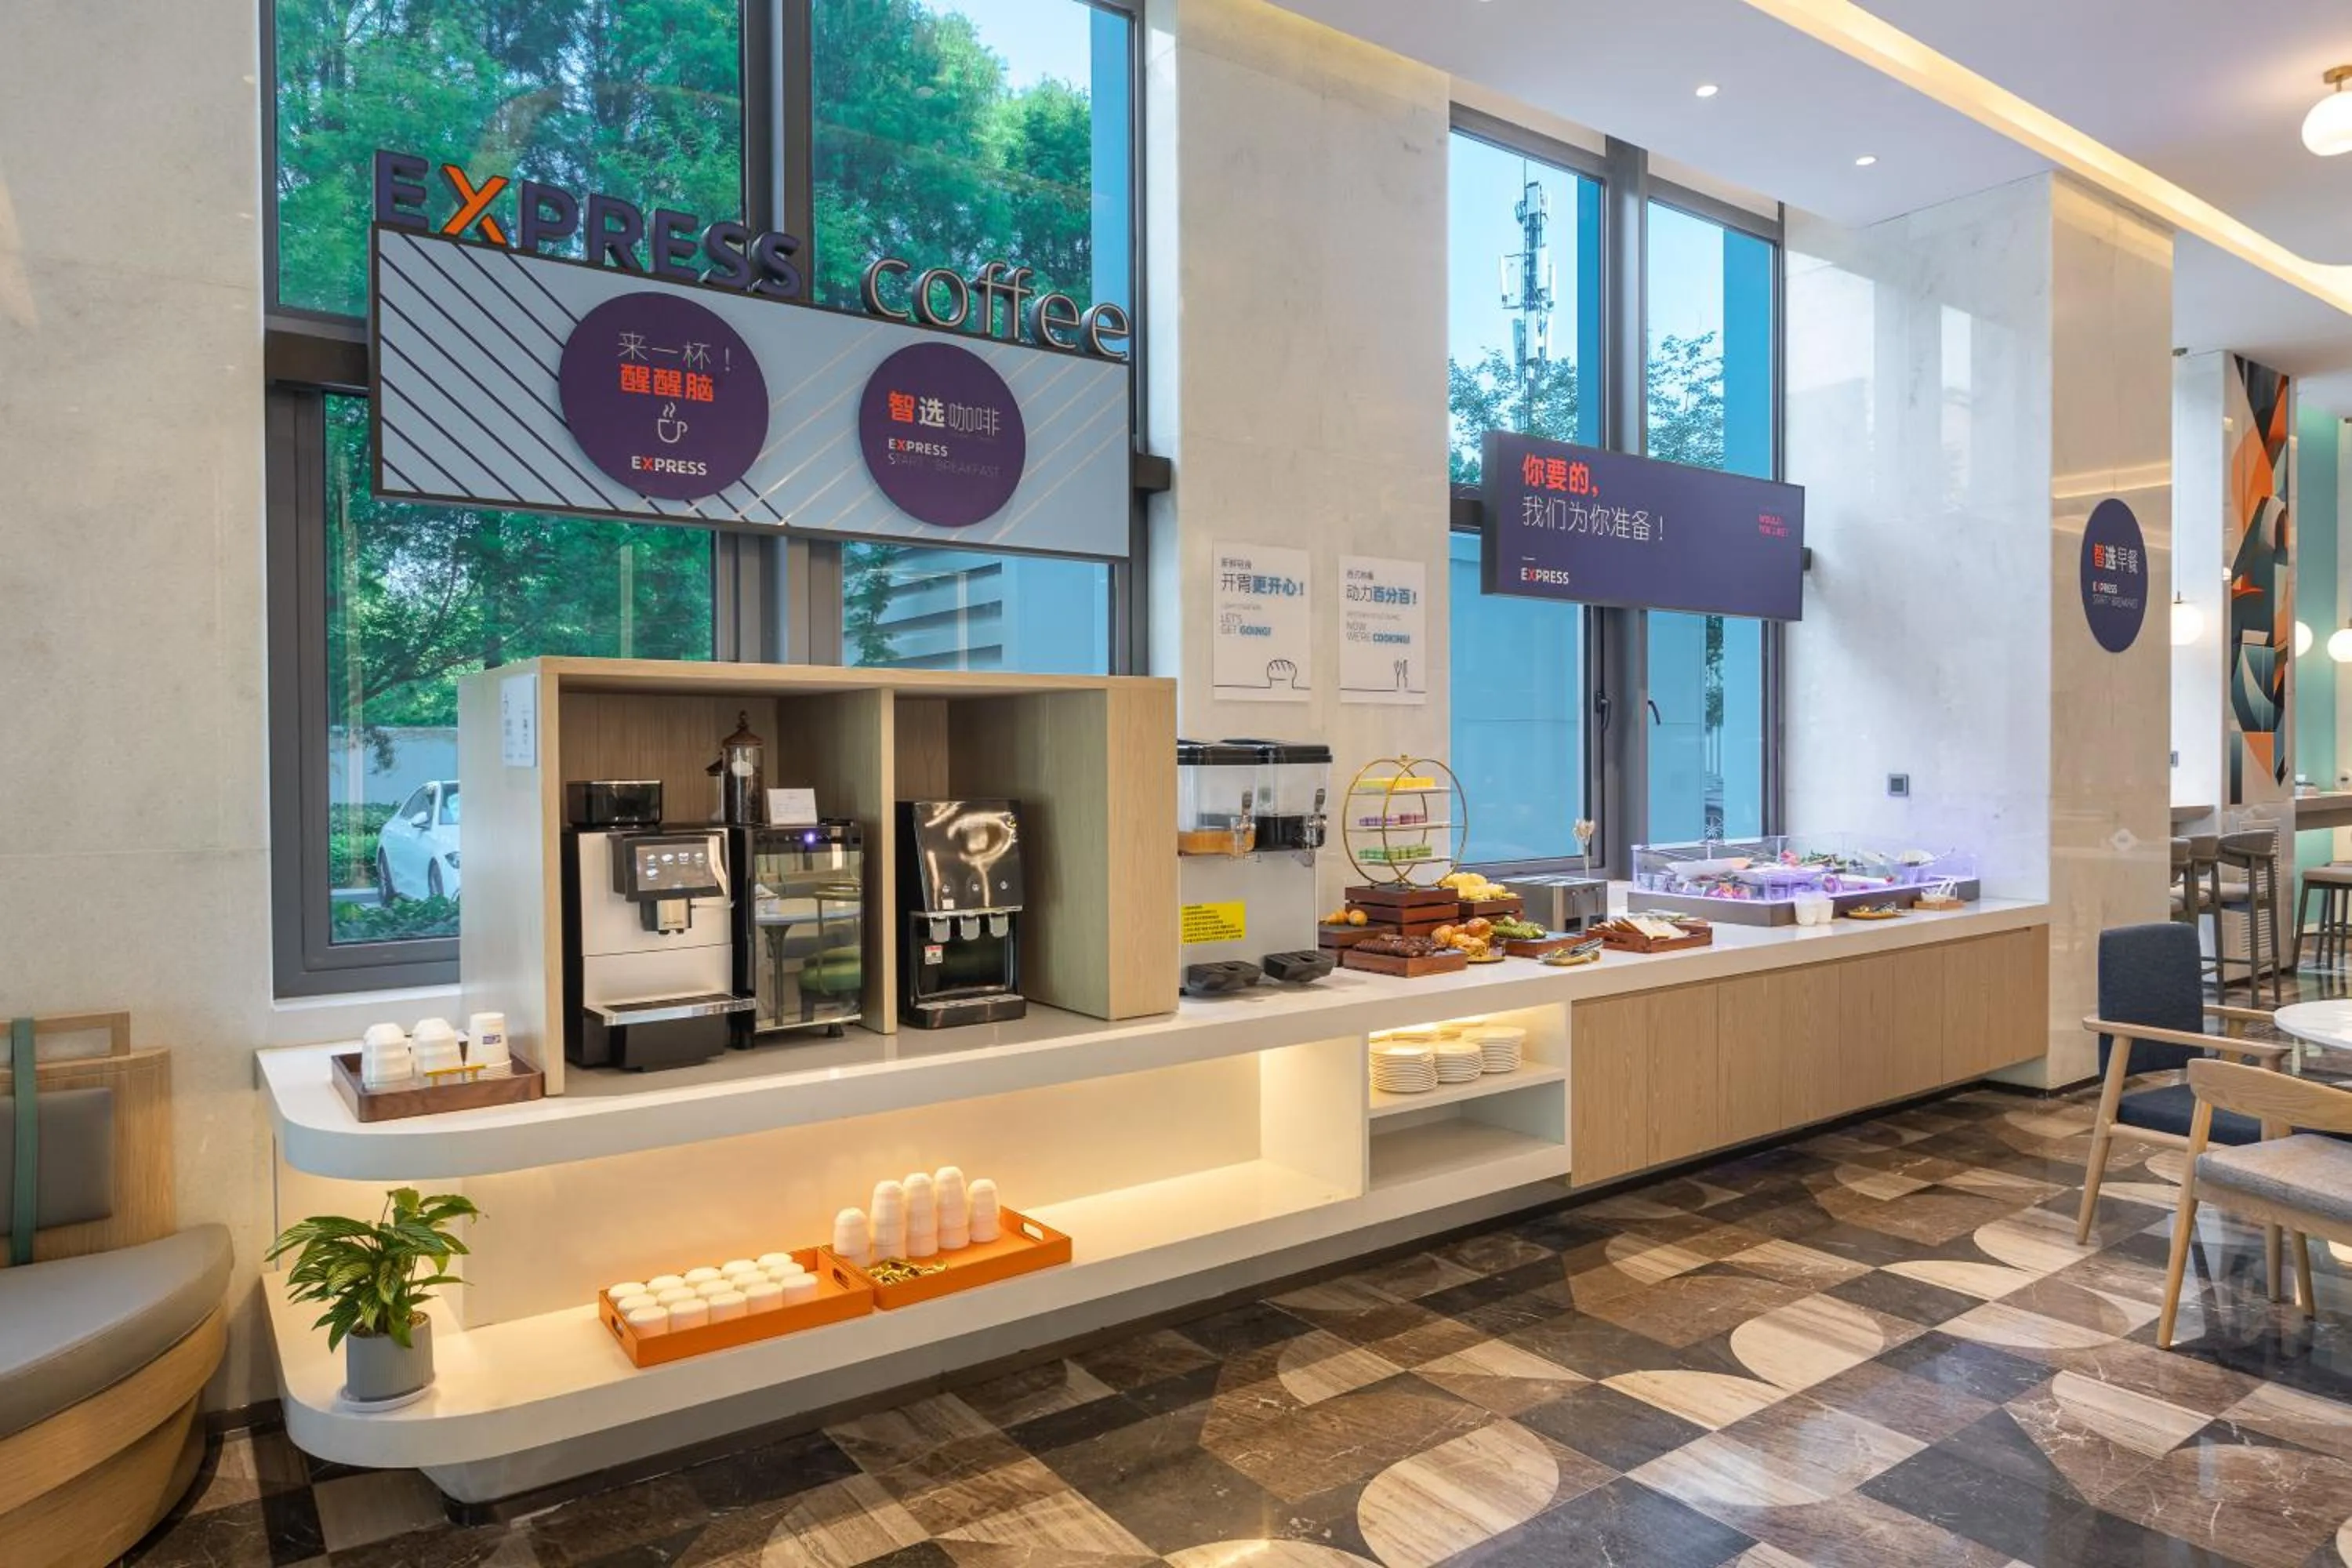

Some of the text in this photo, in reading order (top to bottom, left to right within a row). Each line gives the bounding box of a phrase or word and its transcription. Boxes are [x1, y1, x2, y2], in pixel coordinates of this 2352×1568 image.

[372, 149, 1130, 360] EXPRESS coffee
[617, 331, 731, 372] 来一杯！
[620, 363, 713, 402] 醒醒脑
[888, 390, 1001, 437] 智选咖啡
[630, 456, 707, 477] EXPRESS
[888, 437, 949, 458] EXPRESS
[1522, 495, 1664, 541] 我们为你准备！
[1520, 567, 1569, 584] EXPRESS
